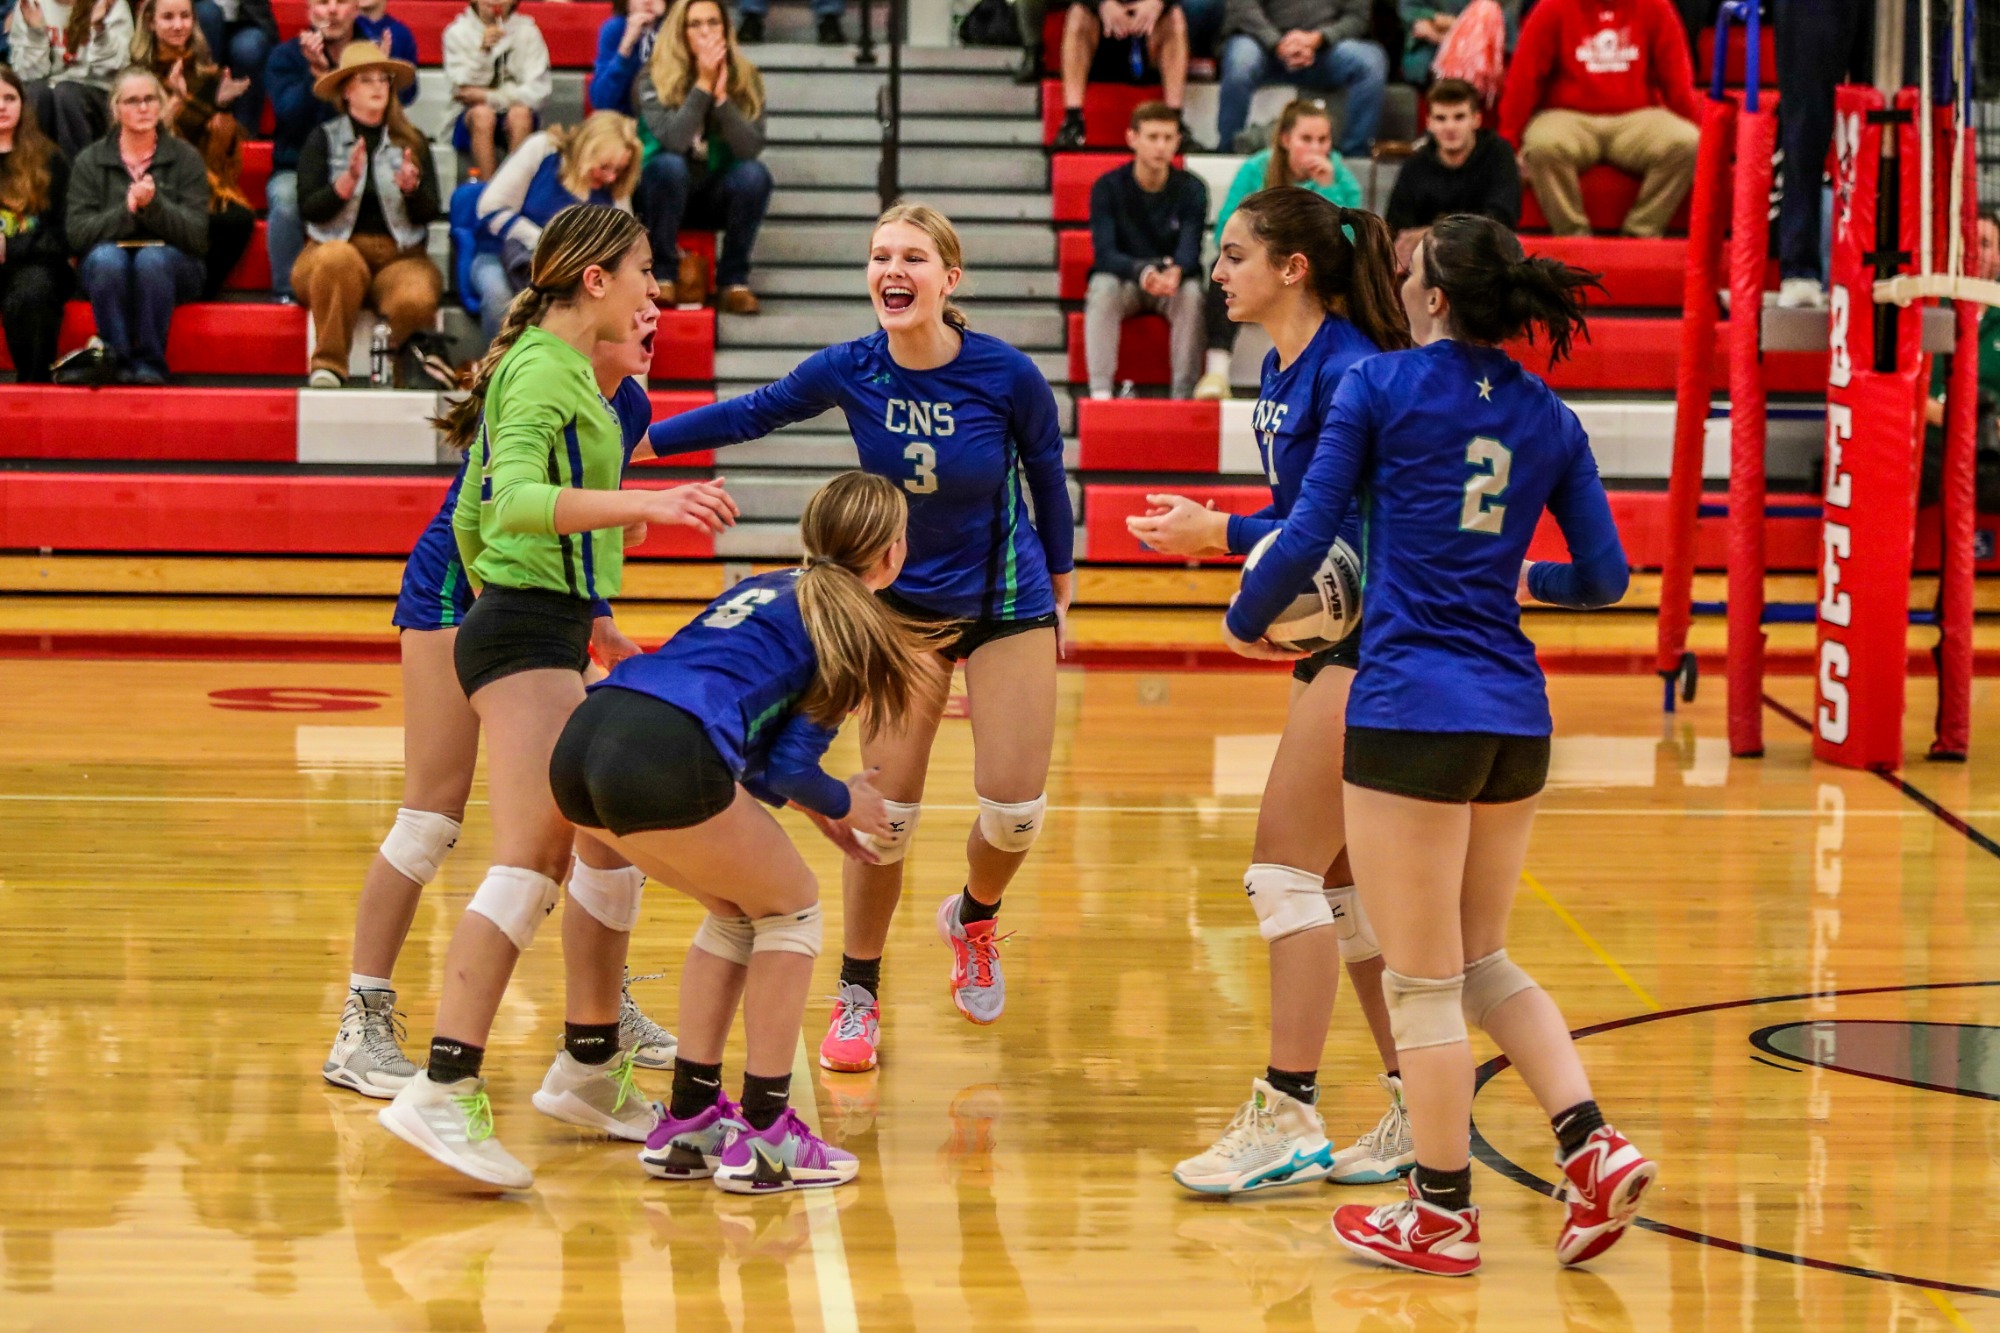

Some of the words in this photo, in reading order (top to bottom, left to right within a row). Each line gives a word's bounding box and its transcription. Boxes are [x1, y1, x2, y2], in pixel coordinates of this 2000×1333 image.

[885, 398, 955, 437] CNS
[1251, 399, 1289, 434] NS
[903, 441, 938, 494] 3
[1458, 434, 1513, 535] 2
[702, 588, 778, 630] 6
